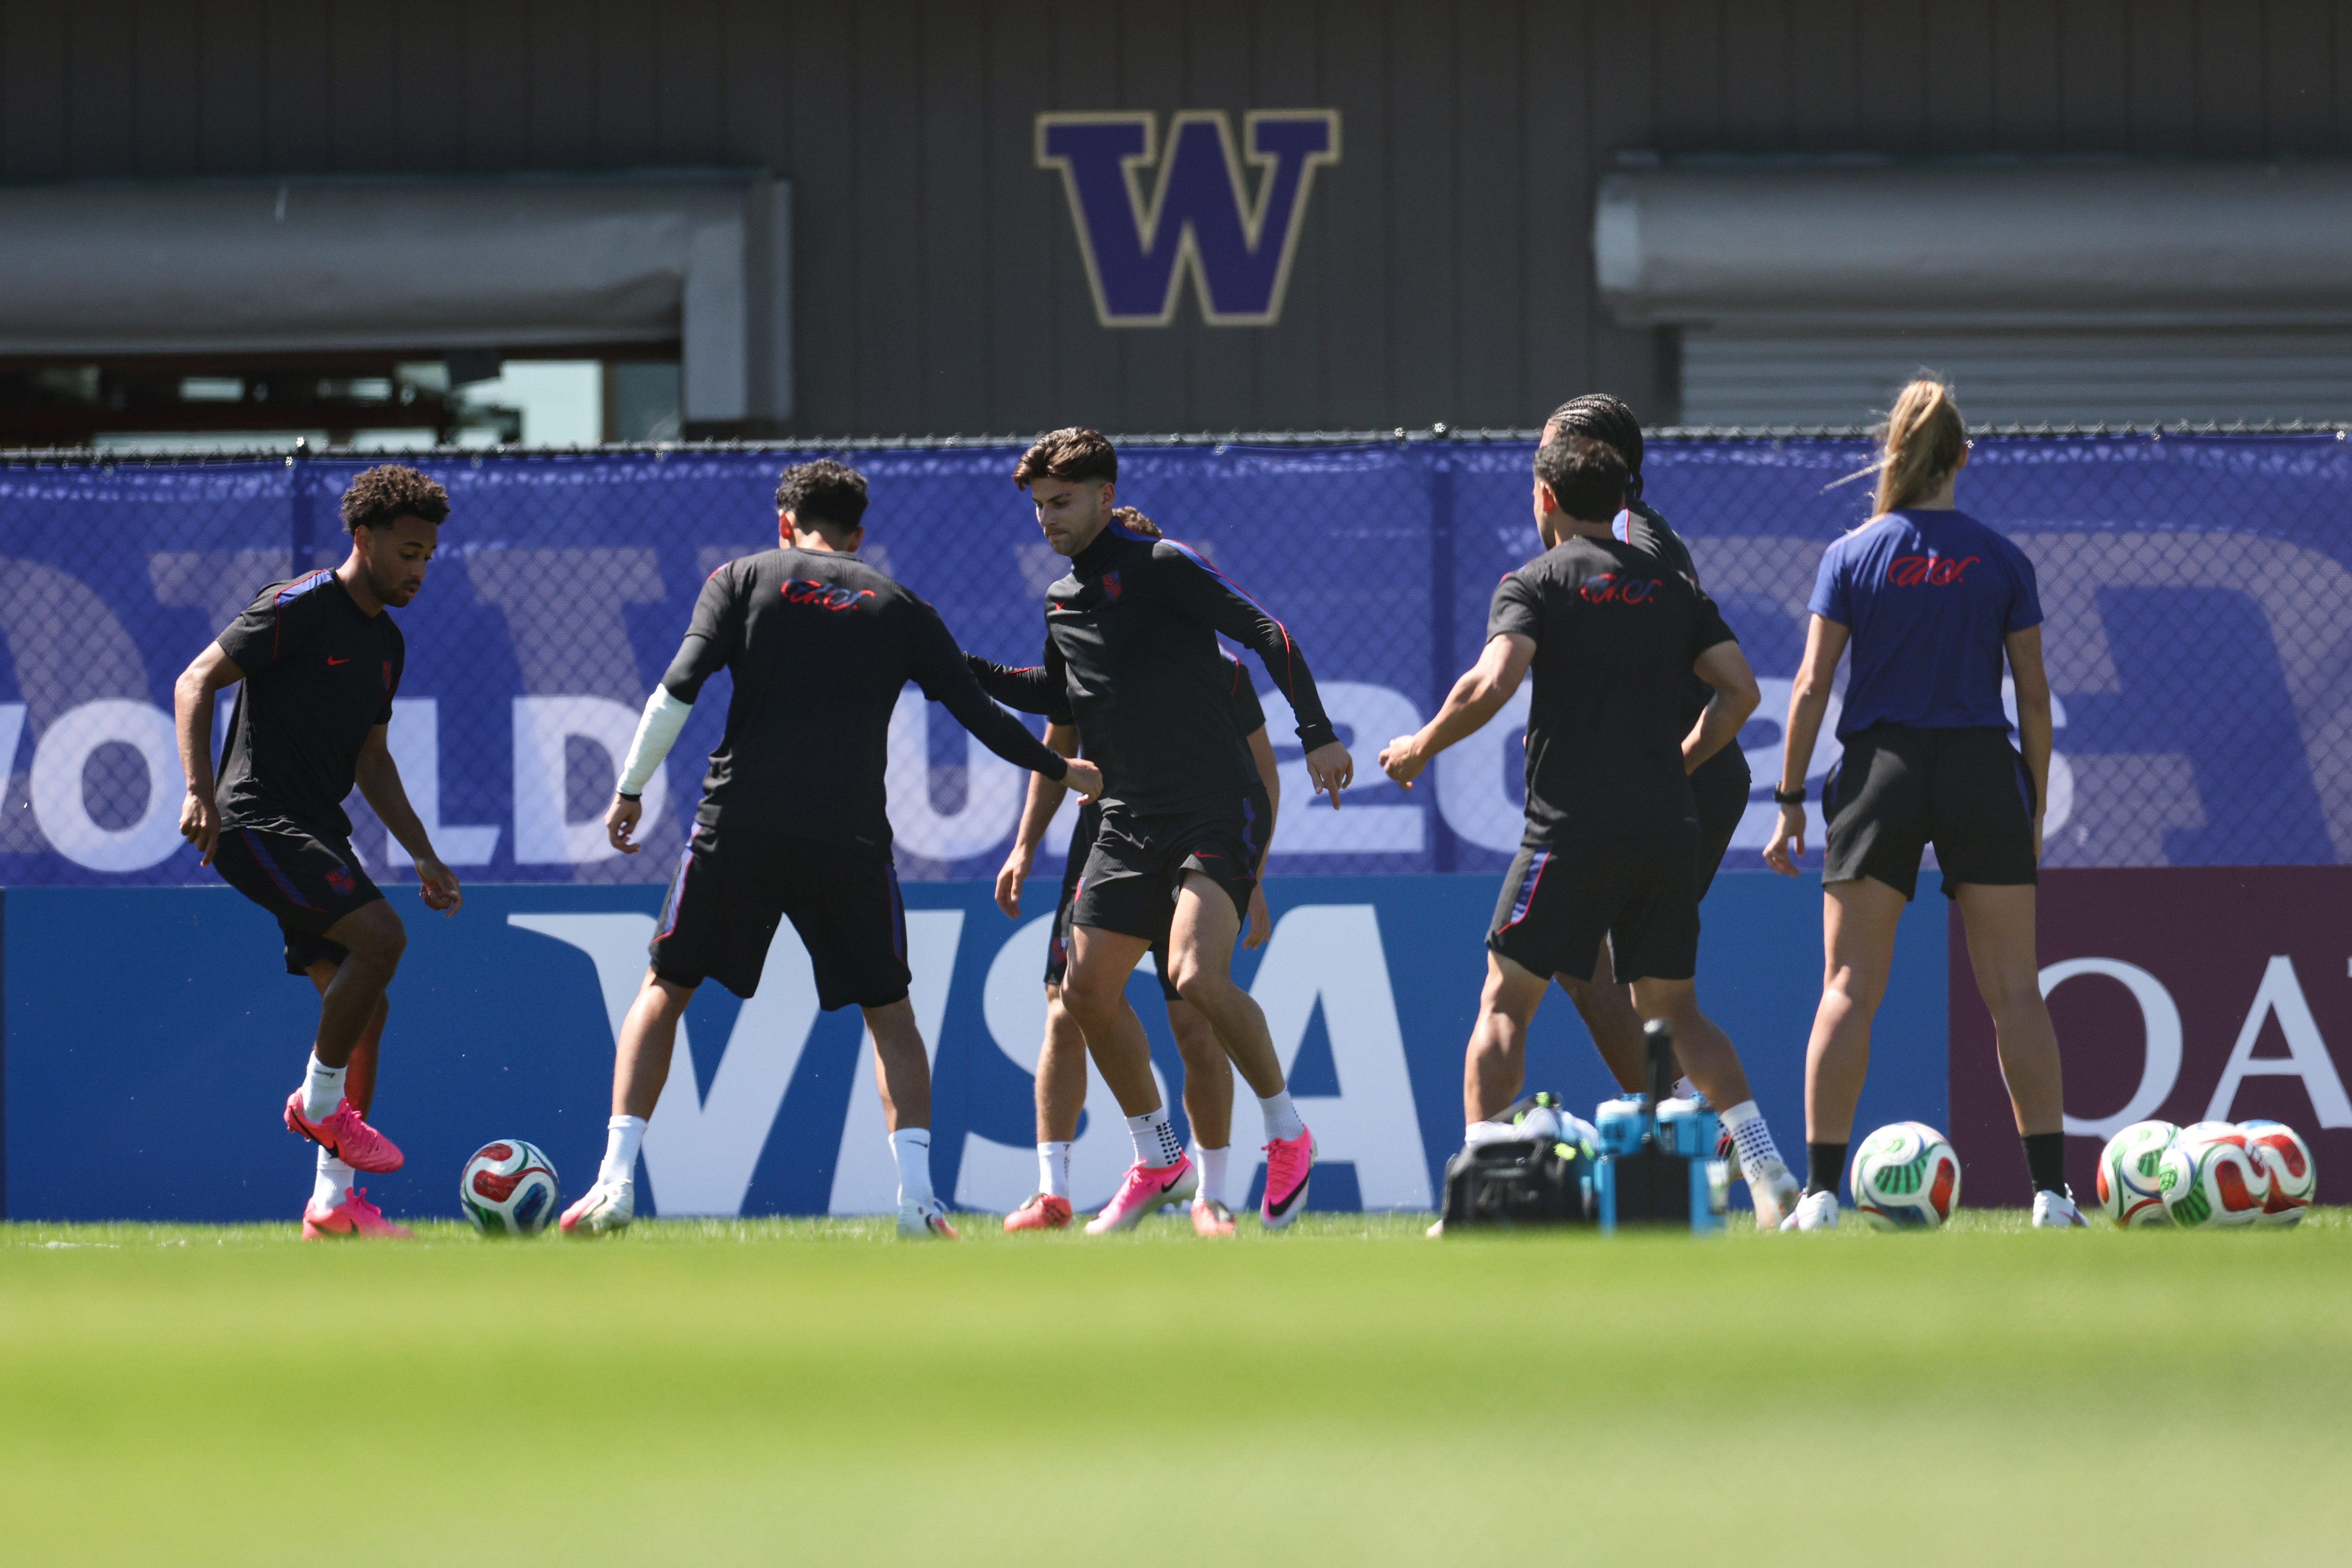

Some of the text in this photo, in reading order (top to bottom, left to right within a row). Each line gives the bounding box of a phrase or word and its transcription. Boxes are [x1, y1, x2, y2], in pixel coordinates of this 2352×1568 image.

[1034, 109, 1342, 327] W
[0, 695, 667, 872] OLD
[508, 902, 1434, 1216] VISA
[2038, 955, 2352, 1142] QA
